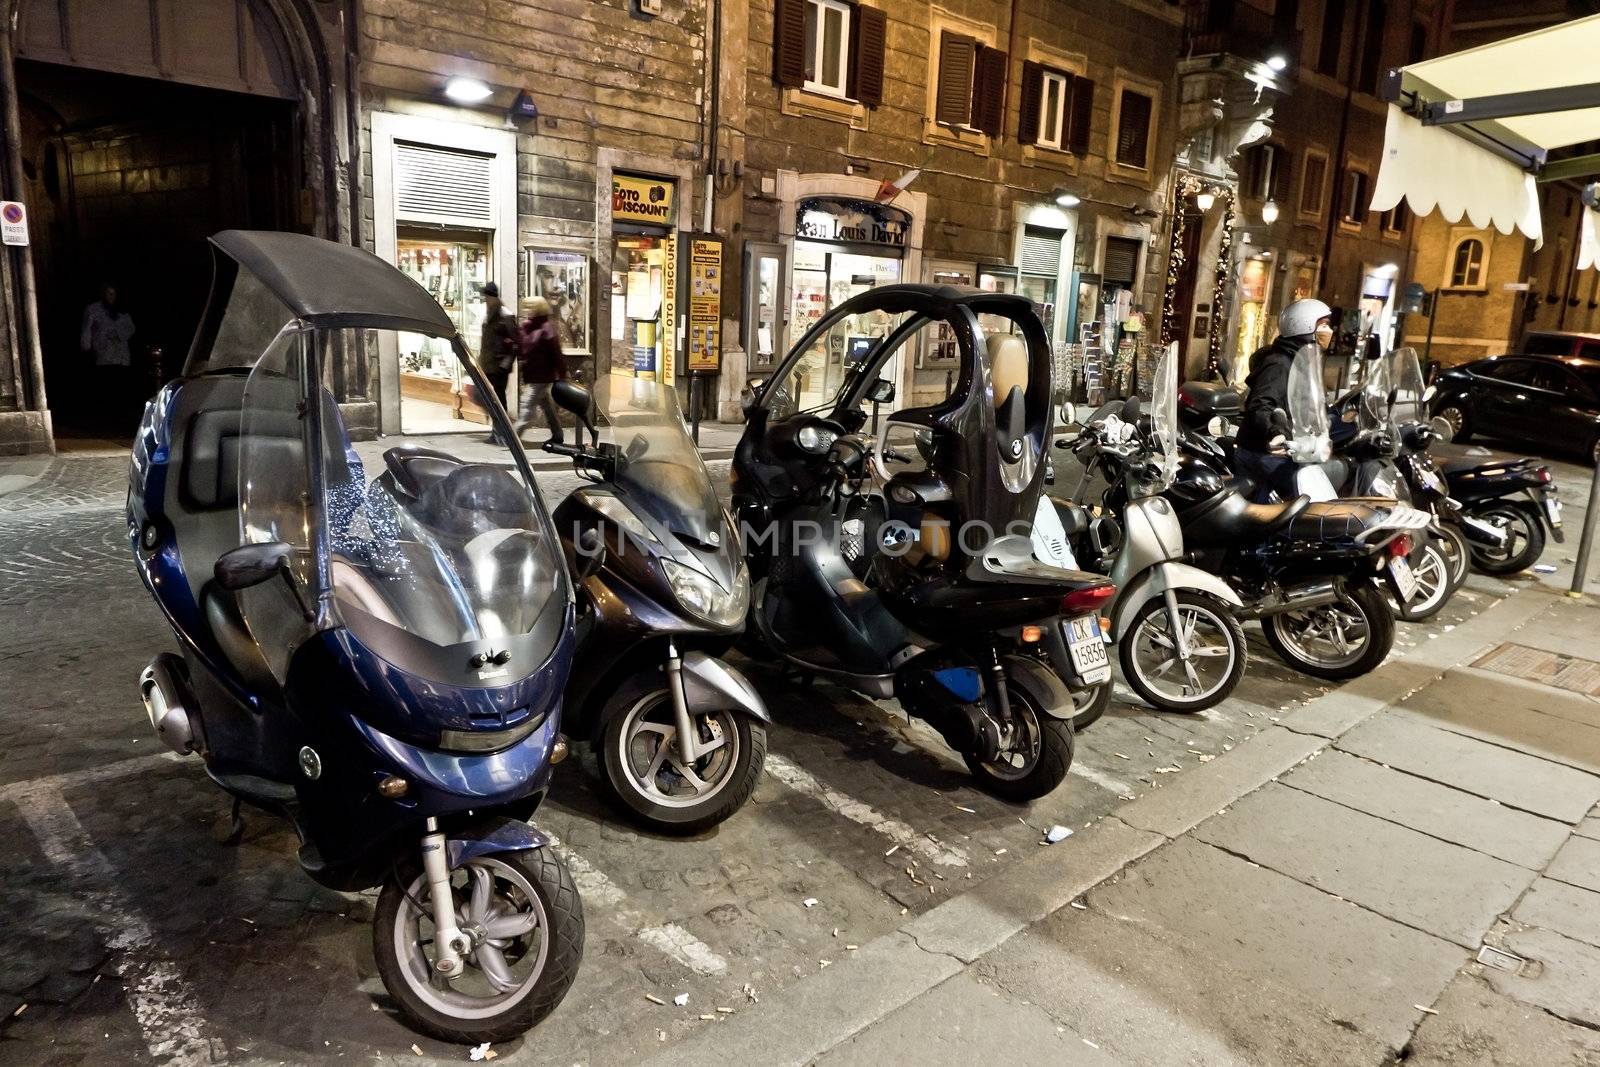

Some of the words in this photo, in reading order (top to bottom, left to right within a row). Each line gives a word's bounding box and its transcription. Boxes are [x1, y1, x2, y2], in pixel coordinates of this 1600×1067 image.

[612, 182, 640, 202] FOTO
[612, 192, 669, 217] DISCOUNT
[833, 219, 867, 241] Louis
[872, 223, 905, 245] David
[666, 234, 675, 299] DISCOUNT
[665, 303, 674, 334] FOTO
[665, 338, 673, 379] PHOTO
[1073, 619, 1089, 640] CK
[1075, 641, 1106, 667] 15836
